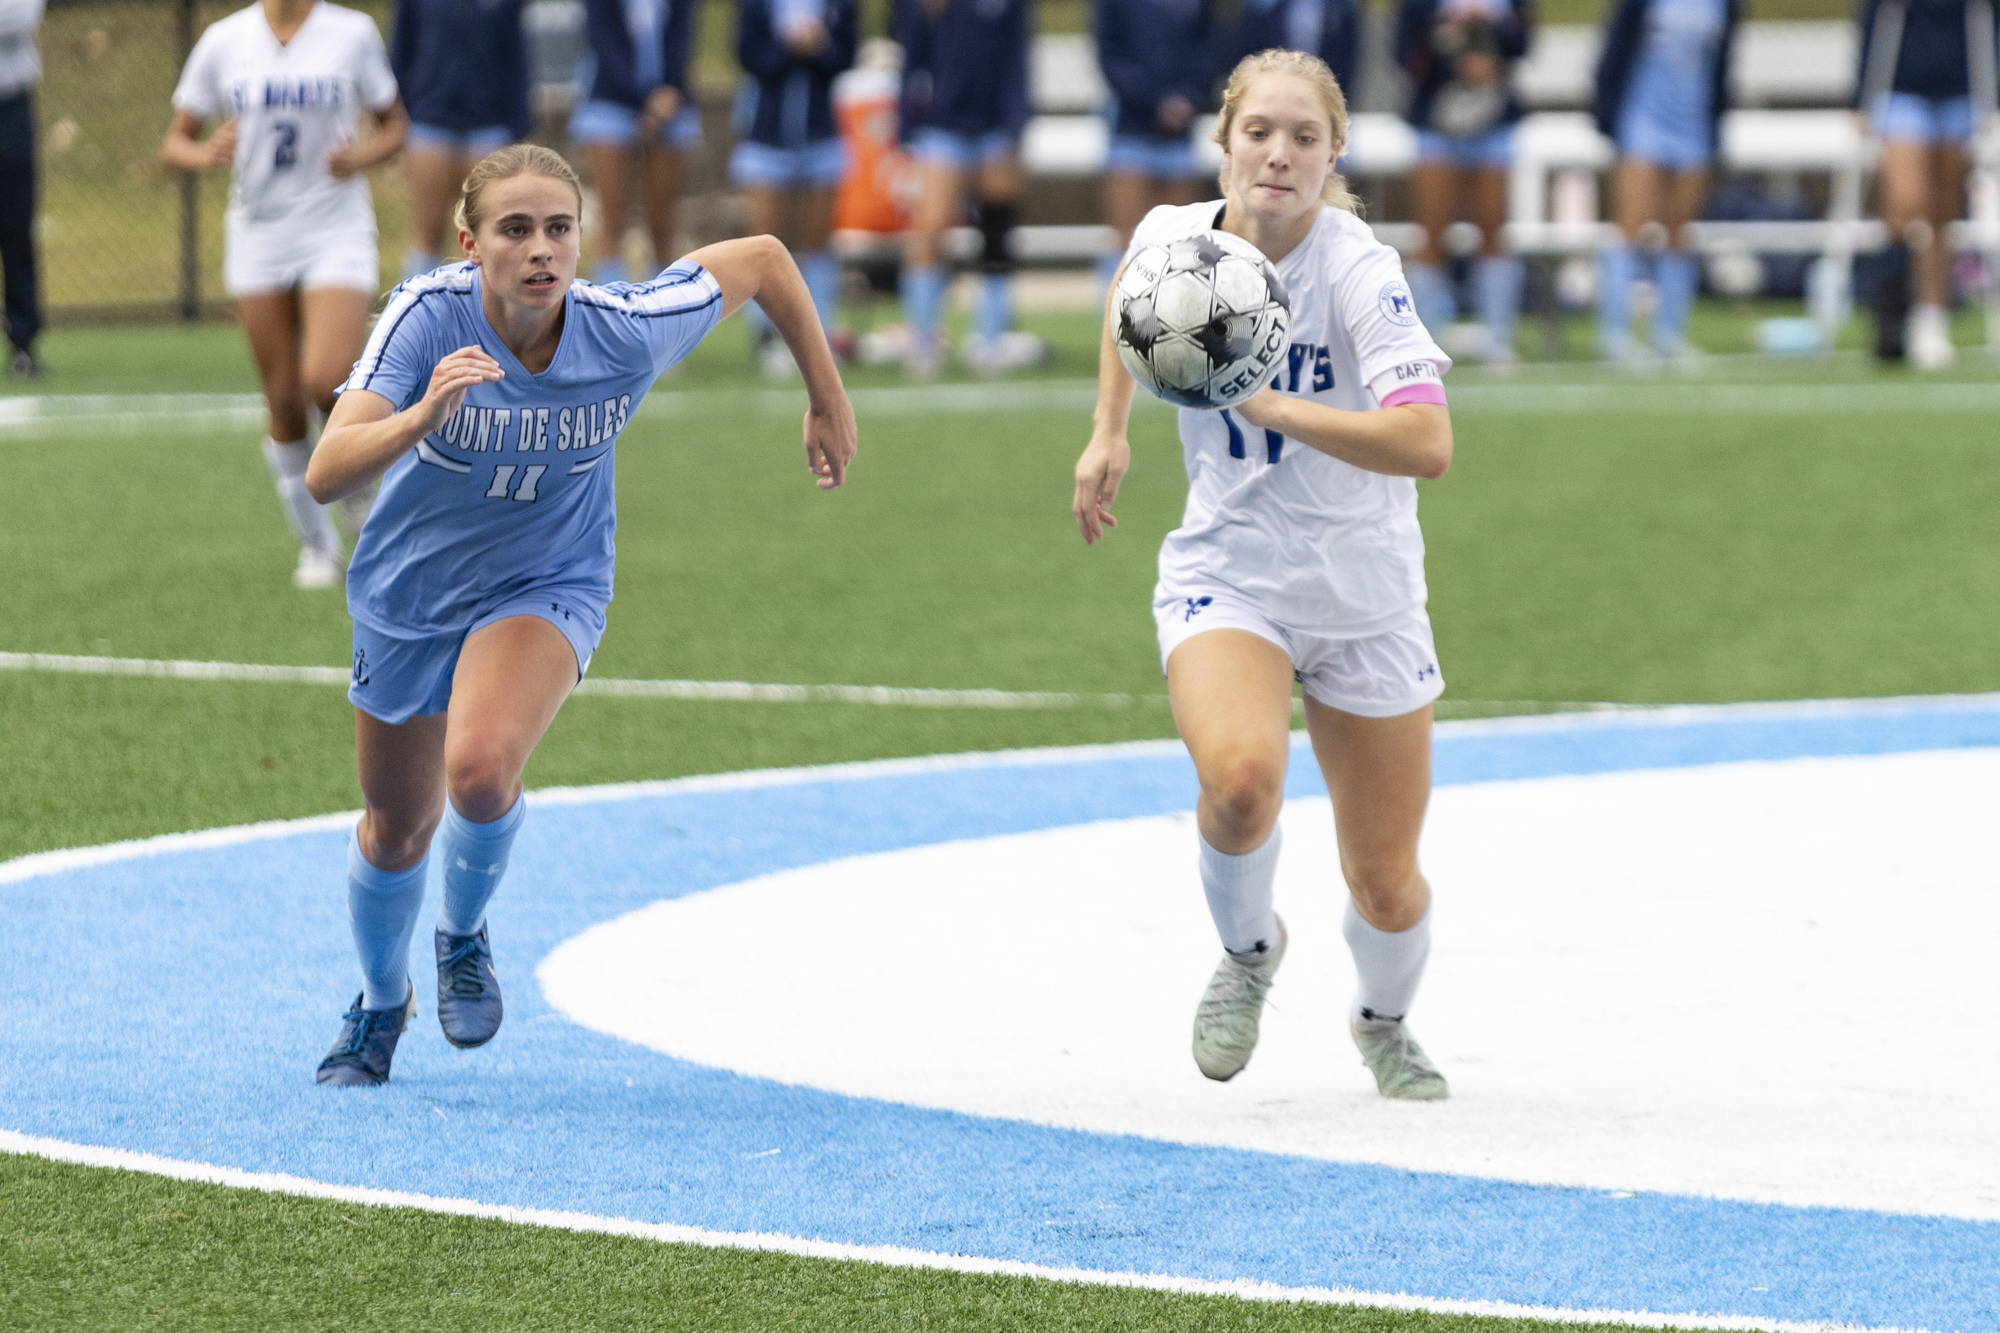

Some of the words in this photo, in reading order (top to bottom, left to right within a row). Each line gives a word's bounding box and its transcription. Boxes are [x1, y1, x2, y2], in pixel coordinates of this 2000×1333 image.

[272, 120, 297, 170] 2
[1391, 294, 1412, 313] M
[1219, 317, 1286, 399] SELECT
[1270, 342, 1335, 393] Y'S
[433, 403, 512, 453] OUNT
[516, 407, 550, 453] DE
[556, 393, 632, 452] SALES
[484, 464, 549, 504] 11
